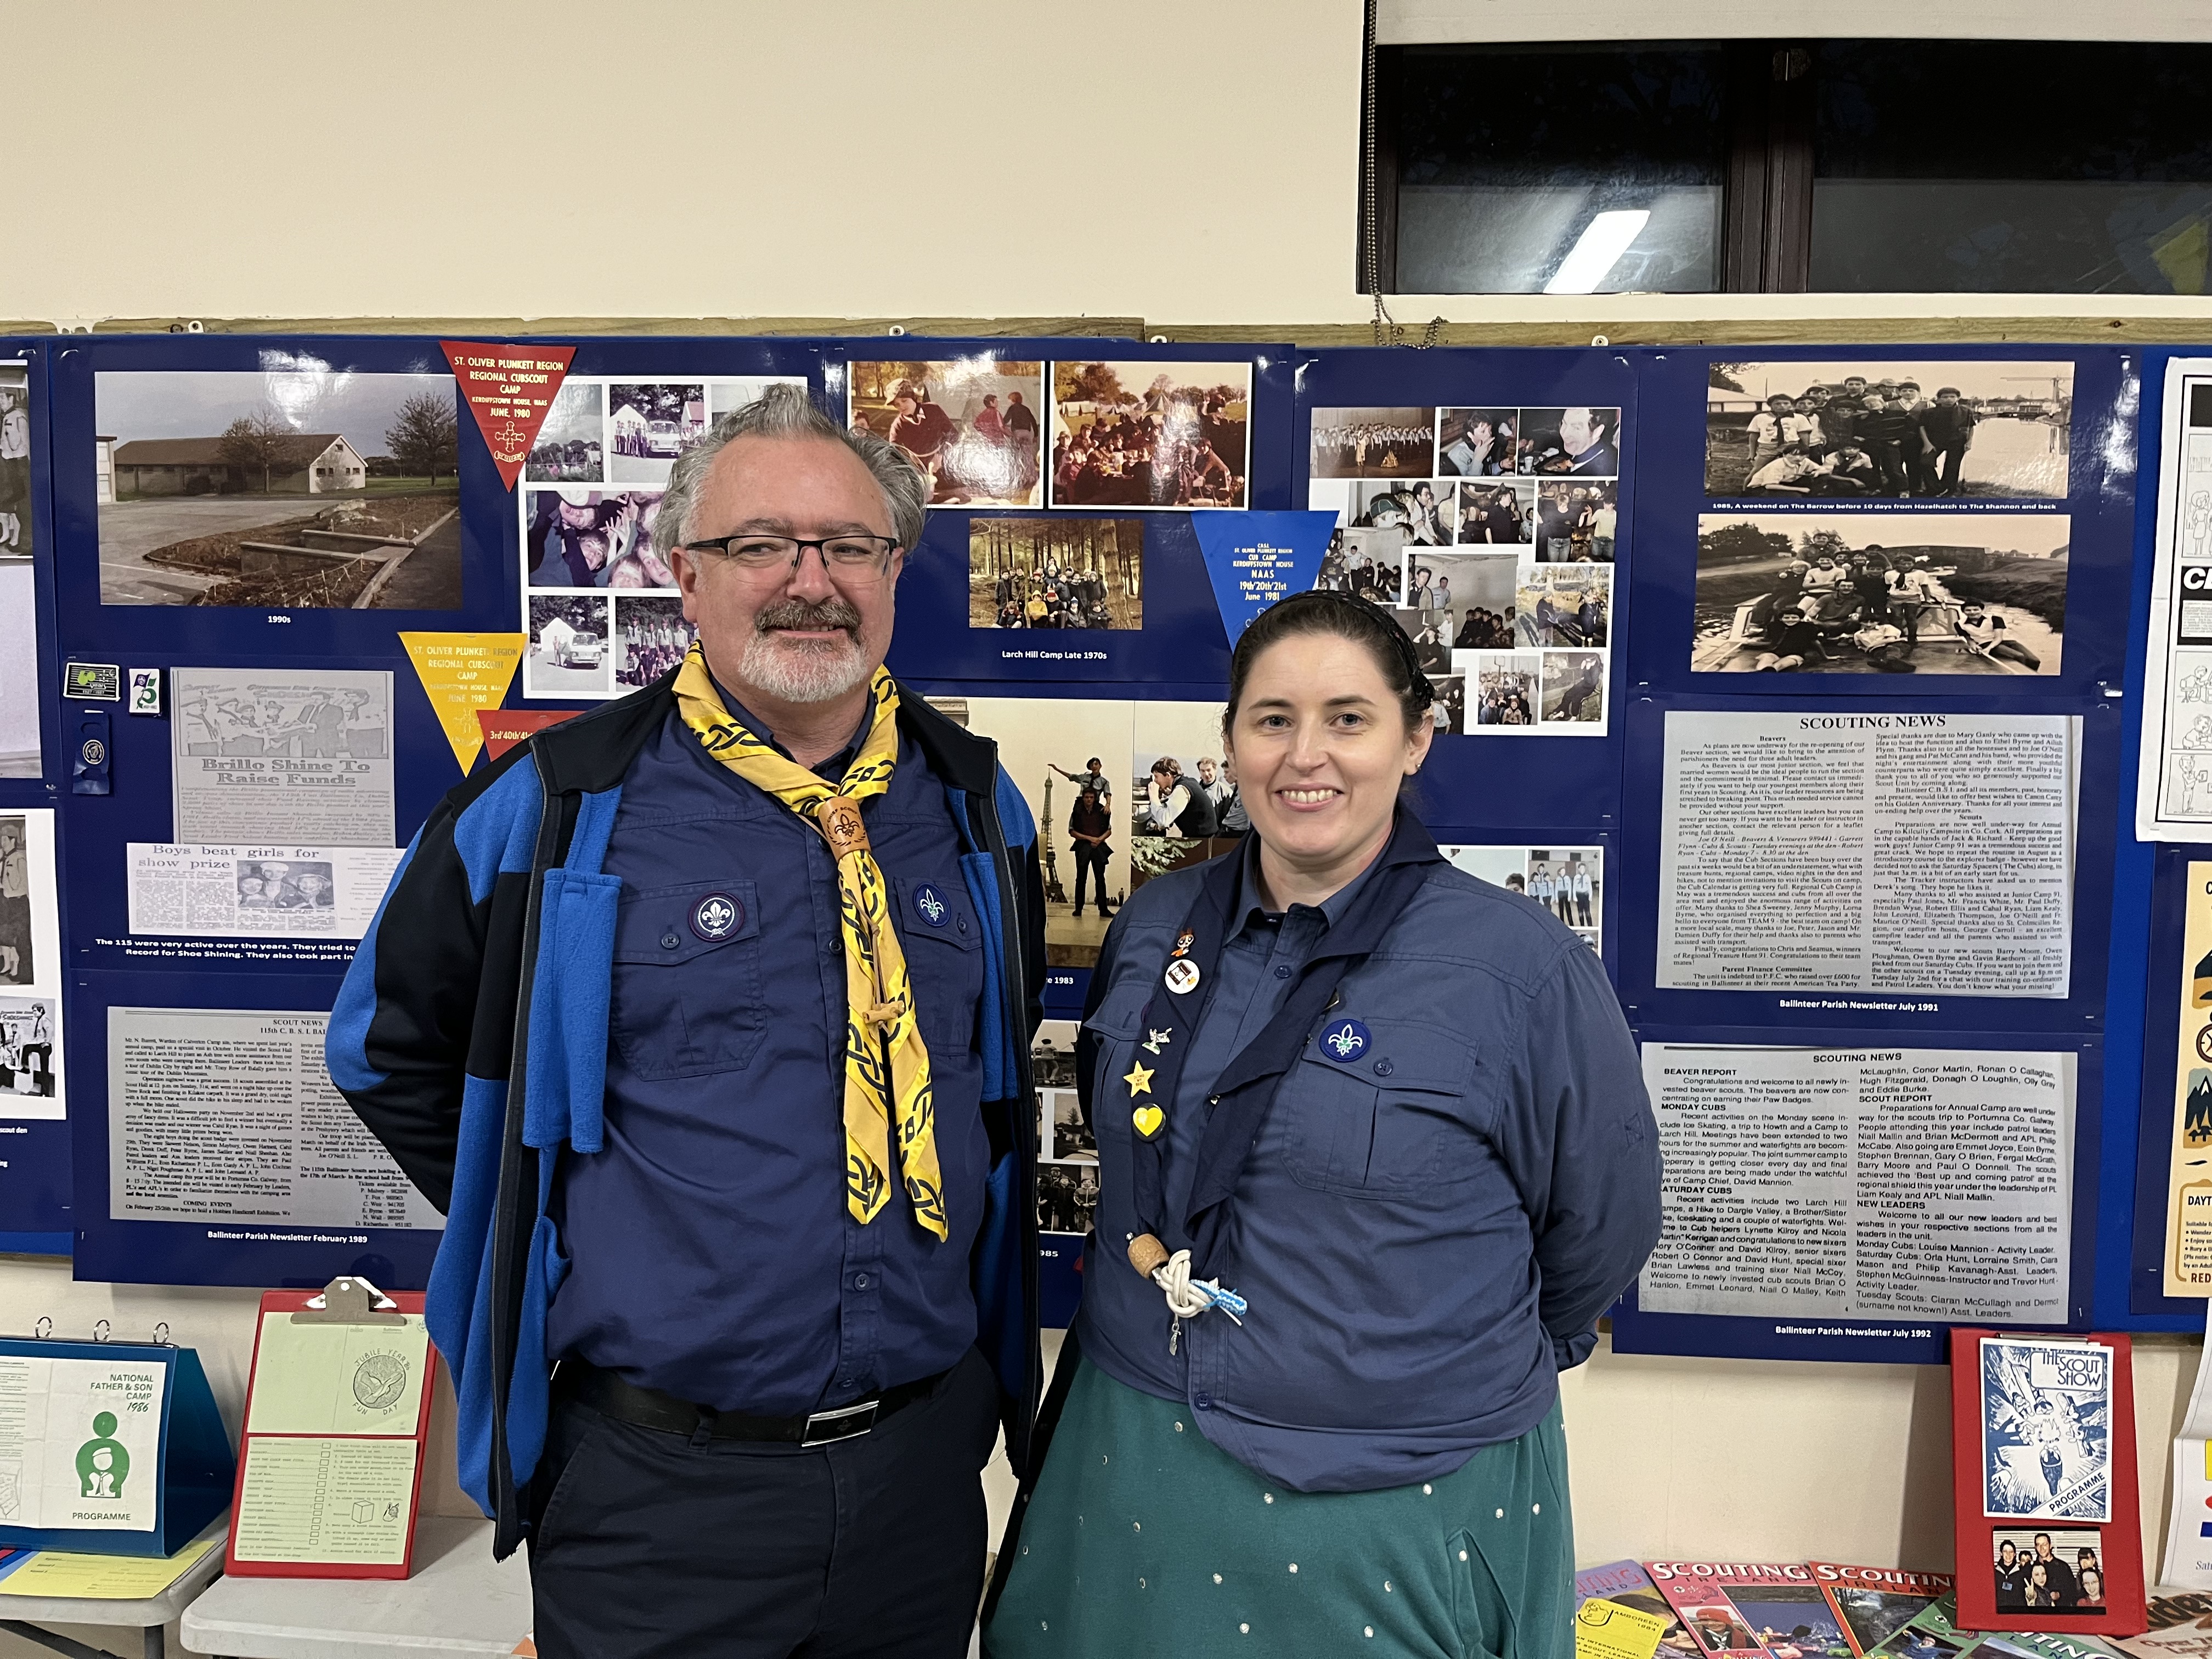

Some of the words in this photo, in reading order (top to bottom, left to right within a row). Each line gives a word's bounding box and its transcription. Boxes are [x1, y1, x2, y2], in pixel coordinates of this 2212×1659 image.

[454, 356, 465, 365] ST.
[467, 357, 495, 368] OLIVER
[498, 359, 534, 370] PLUNKETT
[536, 360, 563, 371] REGION
[470, 371, 508, 382] REGIONAL
[510, 373, 549, 384] CUBSCOUT
[500, 385, 521, 394] CAMP
[490, 407, 511, 418] JUNE,
[514, 408, 531, 418] 1980
[1251, 569, 1274, 579] NAAS
[1245, 591, 1261, 601] June
[1265, 591, 1280, 601] 1981
[268, 616, 291, 624] 1990s
[427, 646, 453, 656] OLIVER
[1040, 651, 1063, 660] Camp
[428, 659, 464, 668] REGIONAL
[457, 672, 478, 680] CAMP
[471, 695, 487, 703] 1980
[1800, 716, 1889, 730] SCOUTING
[1895, 715, 1945, 727] NEWS
[202, 759, 264, 770] Brillo
[272, 759, 333, 771] Shine
[340, 760, 370, 771] To
[217, 773, 280, 784] Raise
[287, 774, 356, 785] Funds
[153, 845, 191, 856] Boys
[202, 846, 237, 856] beat
[247, 847, 284, 858] girls
[294, 848, 319, 859] for
[138, 858, 180, 868] show
[190, 859, 230, 870] prize
[204, 951, 244, 959] Shining.
[1780, 999, 1820, 1008] Ballinteer
[1821, 1000, 1848, 1008] Parish
[1849, 1001, 1897, 1010] Newsletter
[1898, 1002, 1916, 1012] July
[1917, 1003, 1938, 1012] 1991
[1813, 1054, 1866, 1063] SCOUTING
[1870, 1052, 1901, 1061] NEWS
[1879, 1191, 1902, 1200] Kealy
[1944, 1192, 1964, 1200] Niall
[1857, 1200, 1878, 1208] NEW
[1881, 1200, 1926, 1209] LEADERS
[207, 1231, 244, 1239] Ballinteer
[270, 1233, 312, 1242] Newsletter
[313, 1234, 347, 1244] February
[1775, 1325, 1816, 1335] Ballinteer
[1818, 1327, 1843, 1335] Parish
[1845, 1328, 1891, 1336] Newsletter
[1892, 1329, 1909, 1339] July
[1911, 1329, 1931, 1338] 1992
[388, 1349, 406, 1363] YEAR
[2042, 1351, 2059, 1365] THE
[2058, 1356, 2100, 1373] SCOUT
[110, 1374, 154, 1383] NATIONAL
[2057, 1371, 2101, 1386] SHOW
[91, 1383, 123, 1391] FATHER
[134, 1384, 153, 1392] SON
[127, 1402, 149, 1413] 1986
[352, 1402, 368, 1415] FUN
[383, 1403, 397, 1415] DAY
[2049, 1472, 2106, 1513] PROGRAMME
[72, 1512, 131, 1521] PROGRAMME
[1652, 1562, 1809, 1580] SCOUTING
[1817, 1565, 1955, 1587] SCOUTIN
